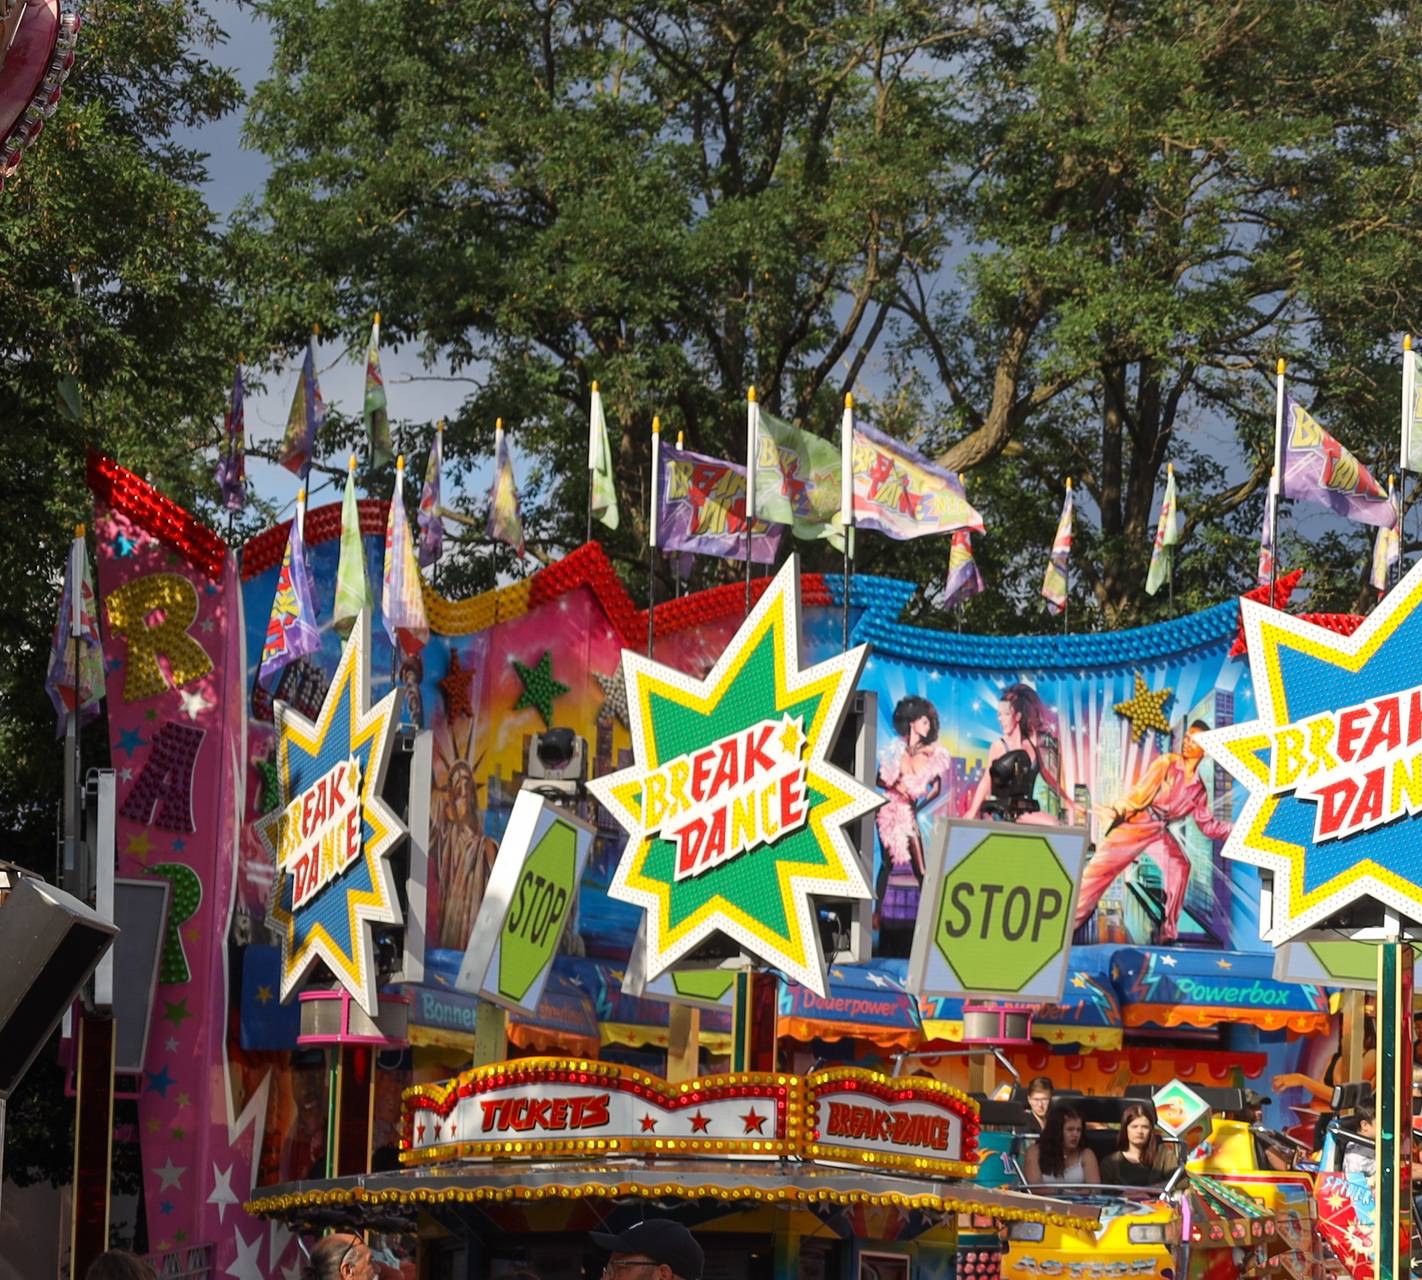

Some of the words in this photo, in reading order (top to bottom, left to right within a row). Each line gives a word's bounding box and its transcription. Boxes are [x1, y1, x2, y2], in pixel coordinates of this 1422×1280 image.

[644, 725, 777, 830] BREAK
[277, 765, 346, 867] BREAK
[671, 767, 804, 874] DANCE
[293, 805, 359, 906] DANCE
[507, 870, 567, 949] STOP
[945, 881, 1063, 943] STOP
[802, 989, 900, 1017] Dauerpower
[1176, 977, 1291, 1006] Powerbox
[479, 1094, 611, 1132] TICKETS
[827, 1102, 889, 1142] BREAK
[890, 1110, 950, 1151] DANCE
